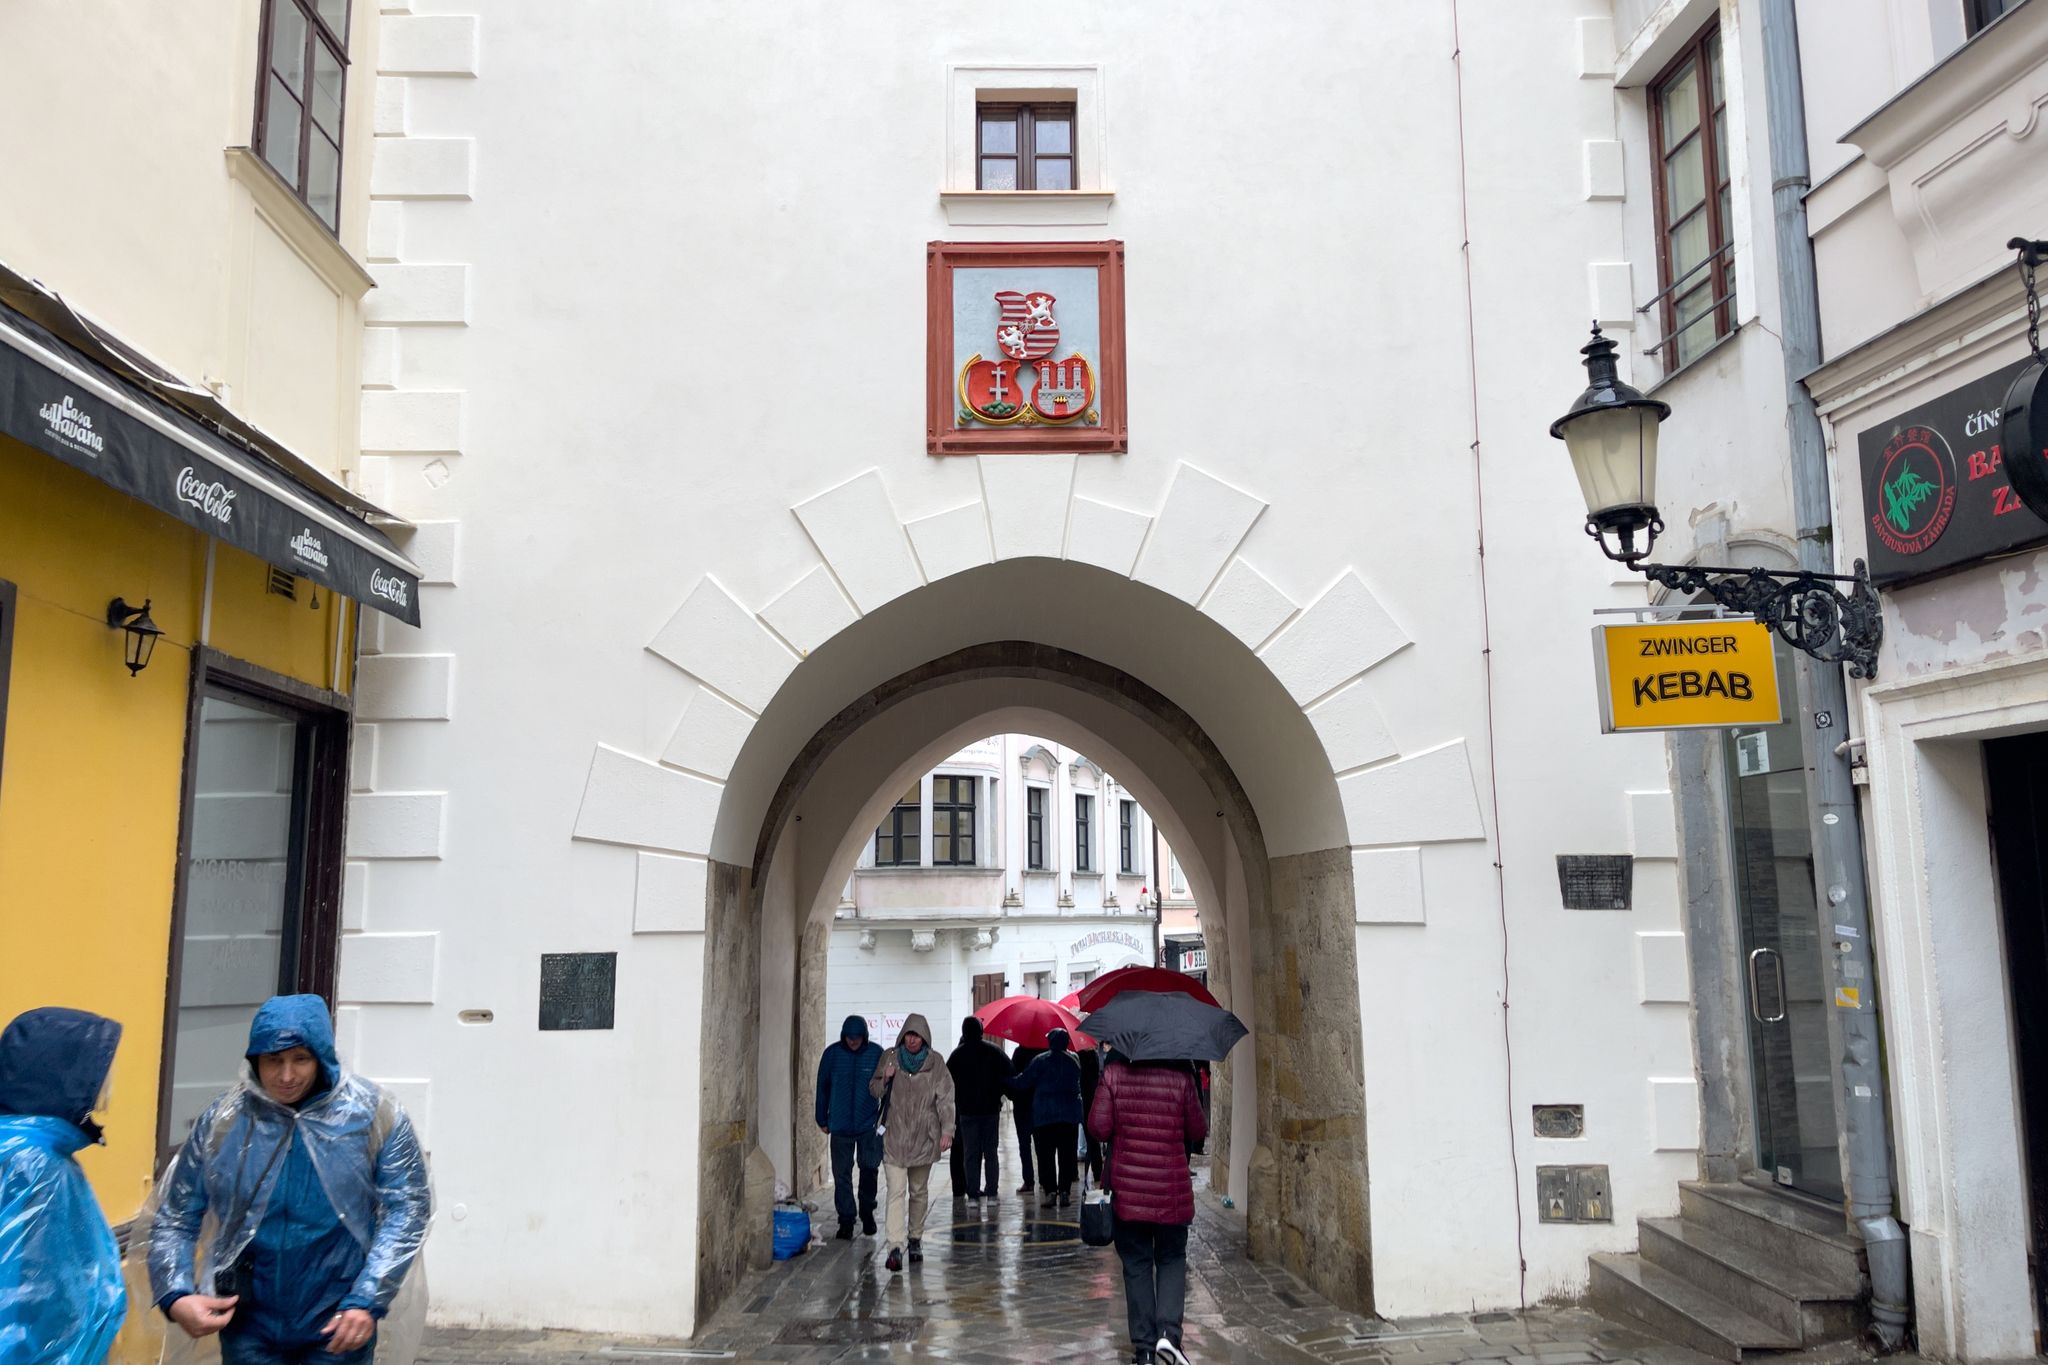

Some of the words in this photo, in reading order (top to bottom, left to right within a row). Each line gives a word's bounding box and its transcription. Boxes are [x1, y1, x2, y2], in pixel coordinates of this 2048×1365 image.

[51, 404, 104, 452] Havana
[63, 395, 93, 428] Casa
[176, 467, 237, 523] Coca-Cola
[296, 535, 328, 567] Havana
[370, 568, 407, 607] Coca-Cola
[1640, 636, 1738, 656] ZWINGER
[1633, 670, 1754, 707] KEBAB
